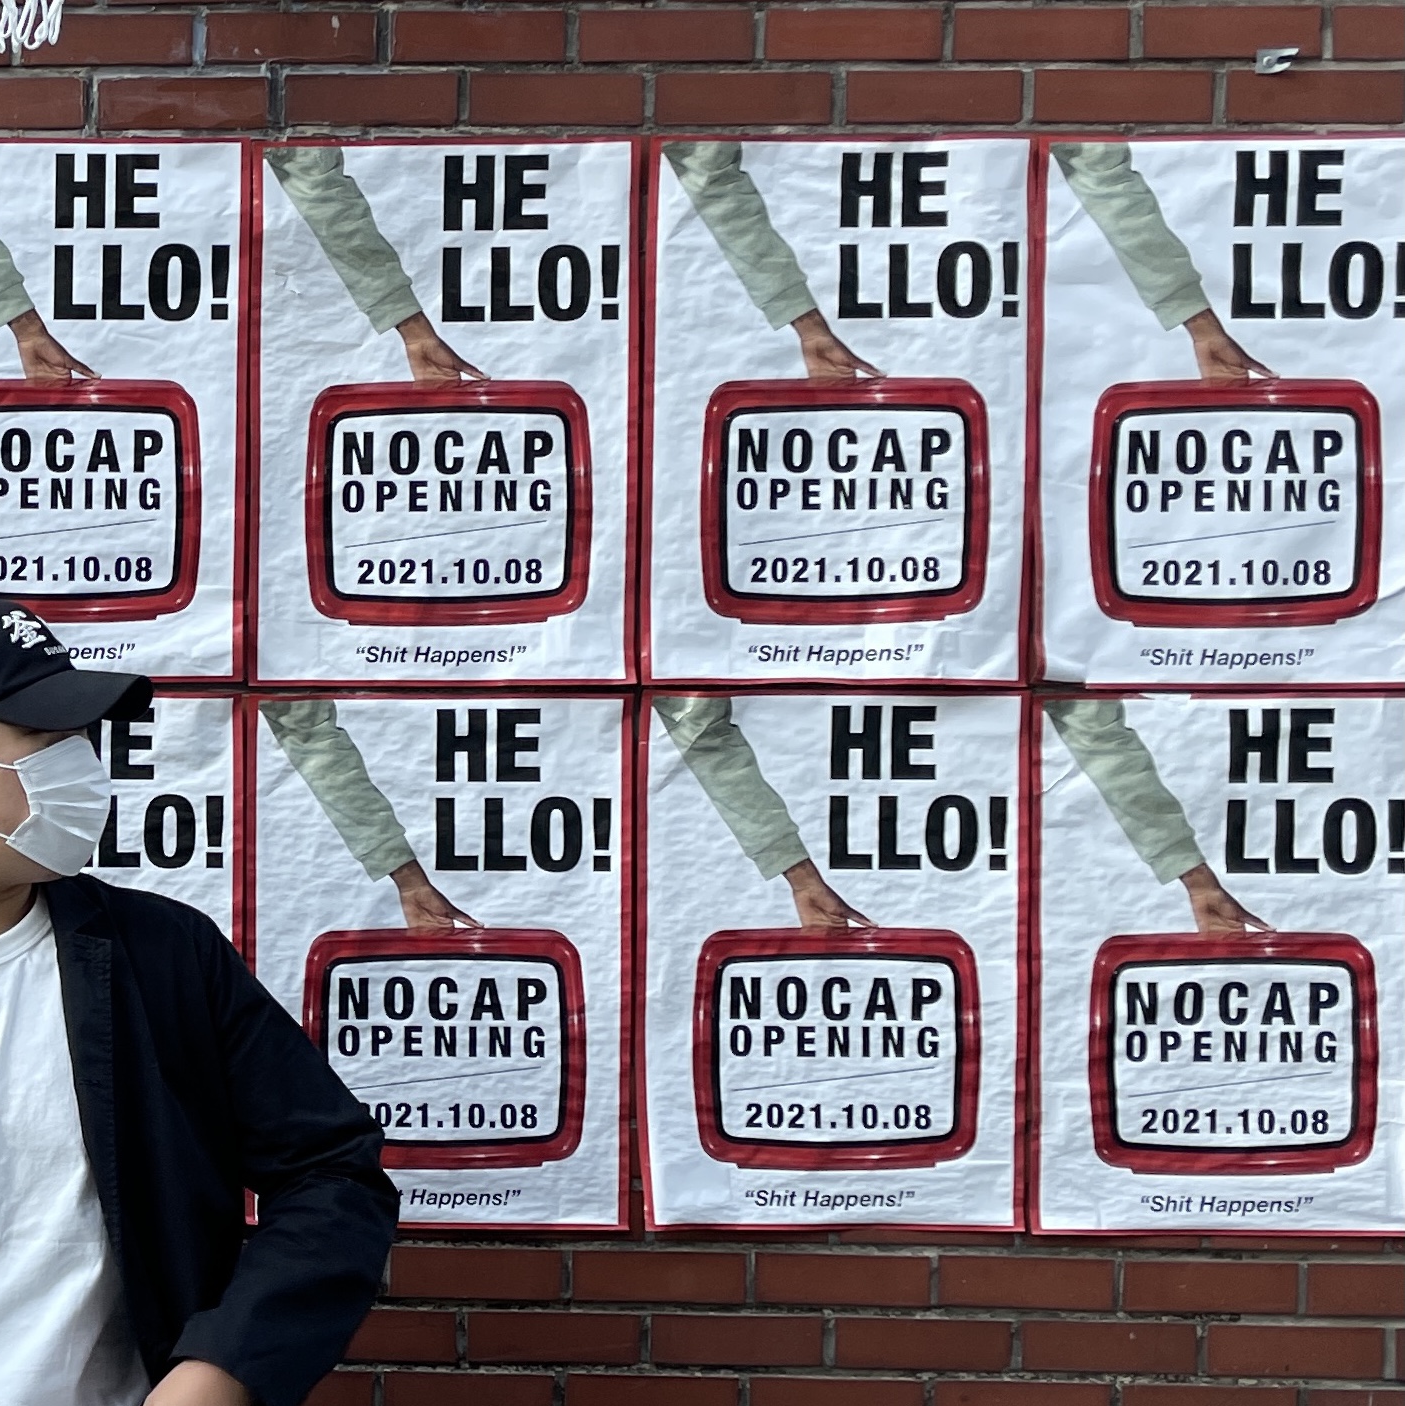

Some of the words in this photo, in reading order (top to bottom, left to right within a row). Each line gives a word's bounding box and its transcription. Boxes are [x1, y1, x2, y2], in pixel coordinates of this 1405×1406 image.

[55, 154, 160, 228] HE
[443, 154, 549, 231] HE
[840, 151, 948, 227] HE
[1234, 150, 1344, 227] HE
[54, 244, 230, 321] LLO!
[442, 245, 620, 322] LLO!
[838, 242, 1019, 319] LLO!
[343, 430, 553, 475] NOCAP
[737, 428, 951, 473] NOCAP
[1127, 430, 1342, 474] NOCAP
[343, 479, 551, 512] OPENING
[737, 478, 948, 510] OPENING
[1127, 480, 1339, 512] OPENING
[358, 559, 542, 584] 2021.10.08
[751, 557, 939, 583] 2021.10.08
[1143, 560, 1330, 585] 2021.10.08
[436, 709, 540, 782] HE
[831, 706, 937, 780] HE
[1229, 708, 1335, 783] HE
[85, 794, 224, 869] LO!
[435, 797, 611, 872] LLO!
[829, 795, 1008, 871] LLO!
[1226, 798, 1405, 874] LLO!
[338, 976, 547, 1021] NOCAP
[730, 977, 941, 1021] NOCAP
[1127, 982, 1339, 1025] NOCAP
[338, 1025, 545, 1058] OPENING
[730, 1025, 939, 1058] OPENING
[1126, 1031, 1336, 1062] OPENING
[746, 1103, 931, 1129] 2021.10.08
[1142, 1109, 1328, 1134] 2021.10.08
